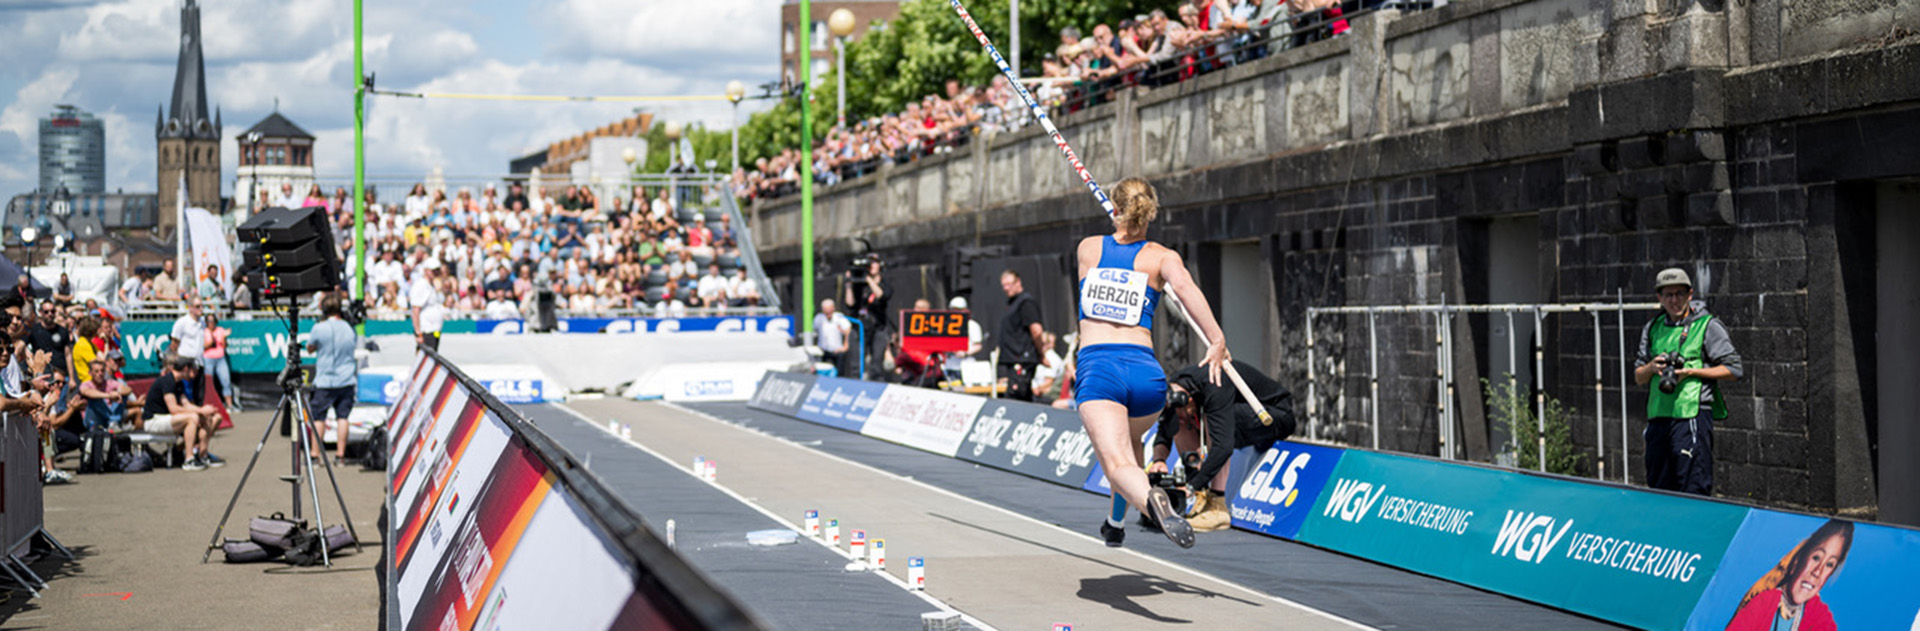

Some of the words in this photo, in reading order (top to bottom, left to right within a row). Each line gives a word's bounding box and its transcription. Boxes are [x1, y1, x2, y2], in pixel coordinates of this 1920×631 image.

[1099, 269, 1133, 285] GLS.
[1087, 283, 1139, 307] HERZIG
[909, 313, 964, 335] 0:42
[1323, 478, 1386, 523] WGV
[1377, 495, 1473, 535] VERSICHERUNG
[1491, 509, 1574, 564] WGV
[1566, 532, 1701, 583] VERSICHERUNG
